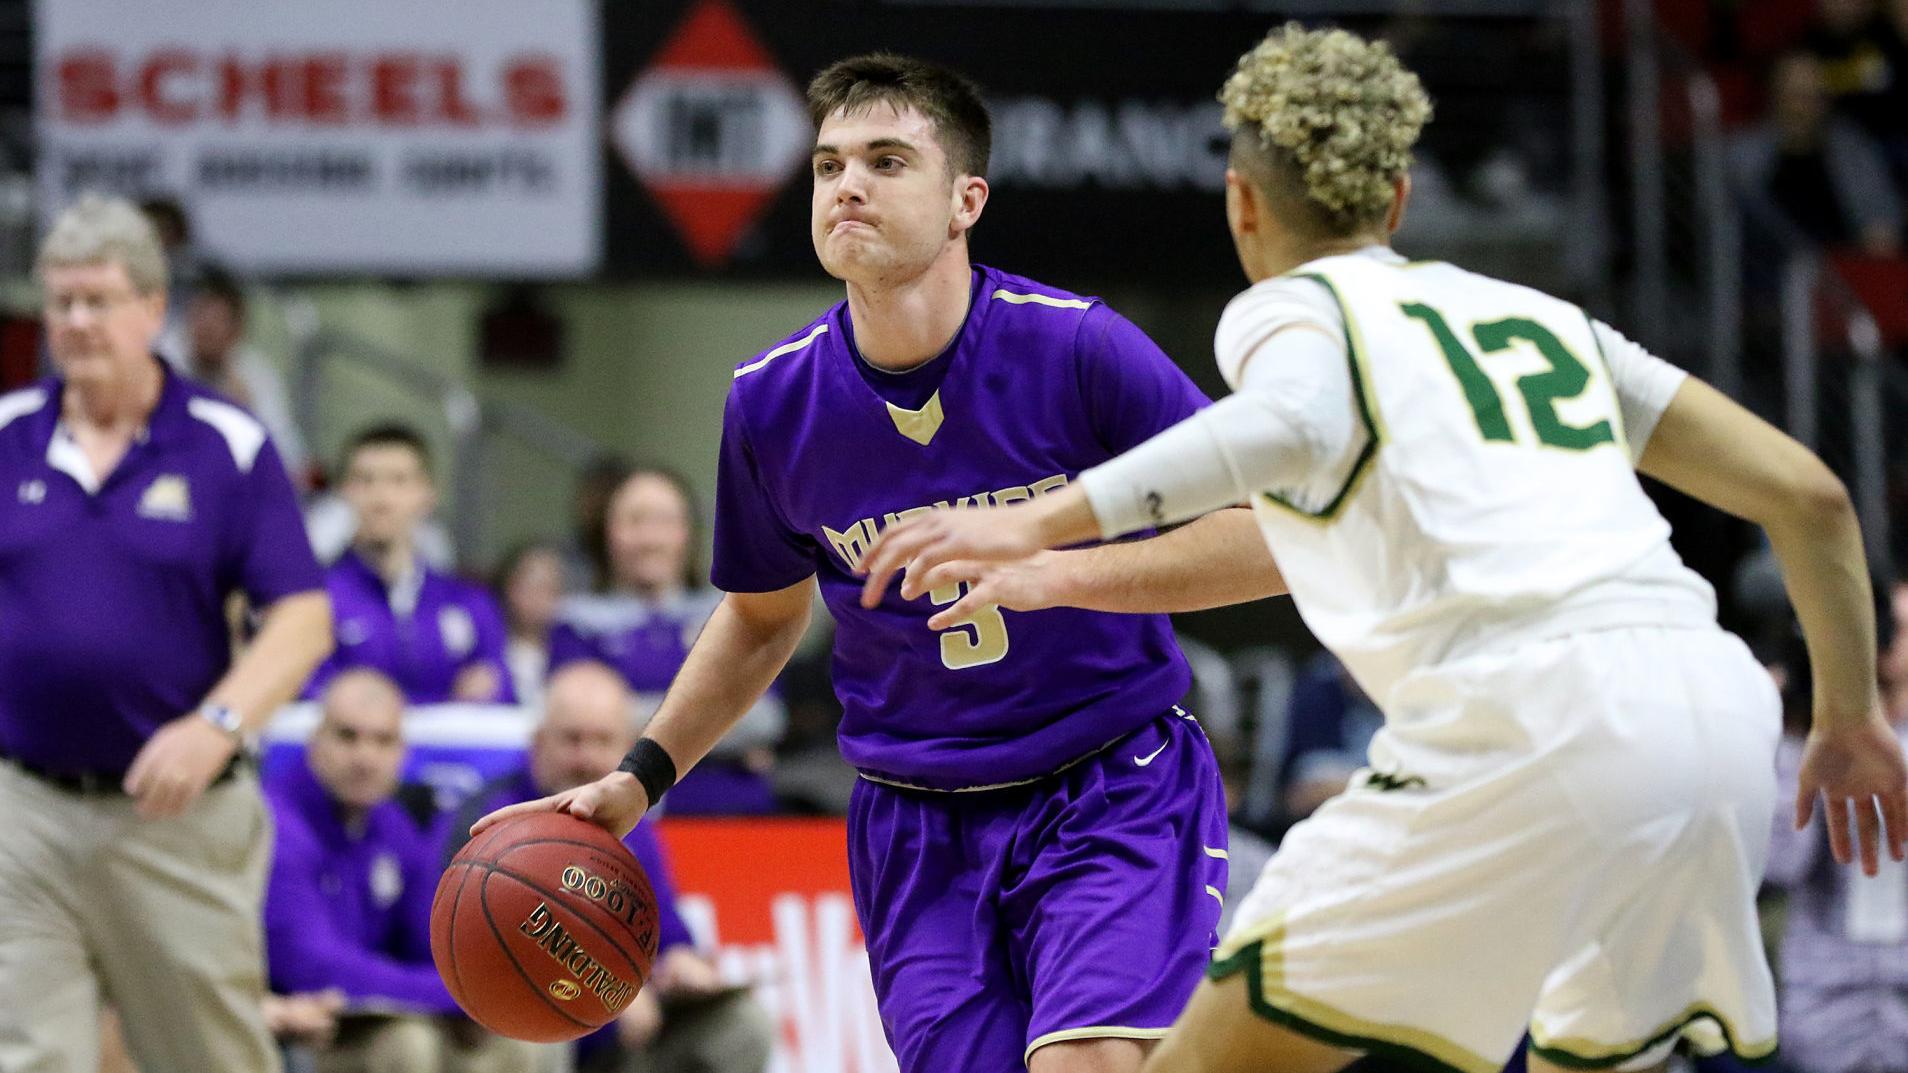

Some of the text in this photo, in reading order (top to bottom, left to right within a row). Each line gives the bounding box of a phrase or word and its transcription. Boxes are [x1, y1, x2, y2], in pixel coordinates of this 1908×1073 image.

[58, 49, 567, 128] SCHEELS
[1396, 302, 1616, 451] 12
[929, 578, 1009, 670] 3
[519, 901, 634, 1013] SPALDING
